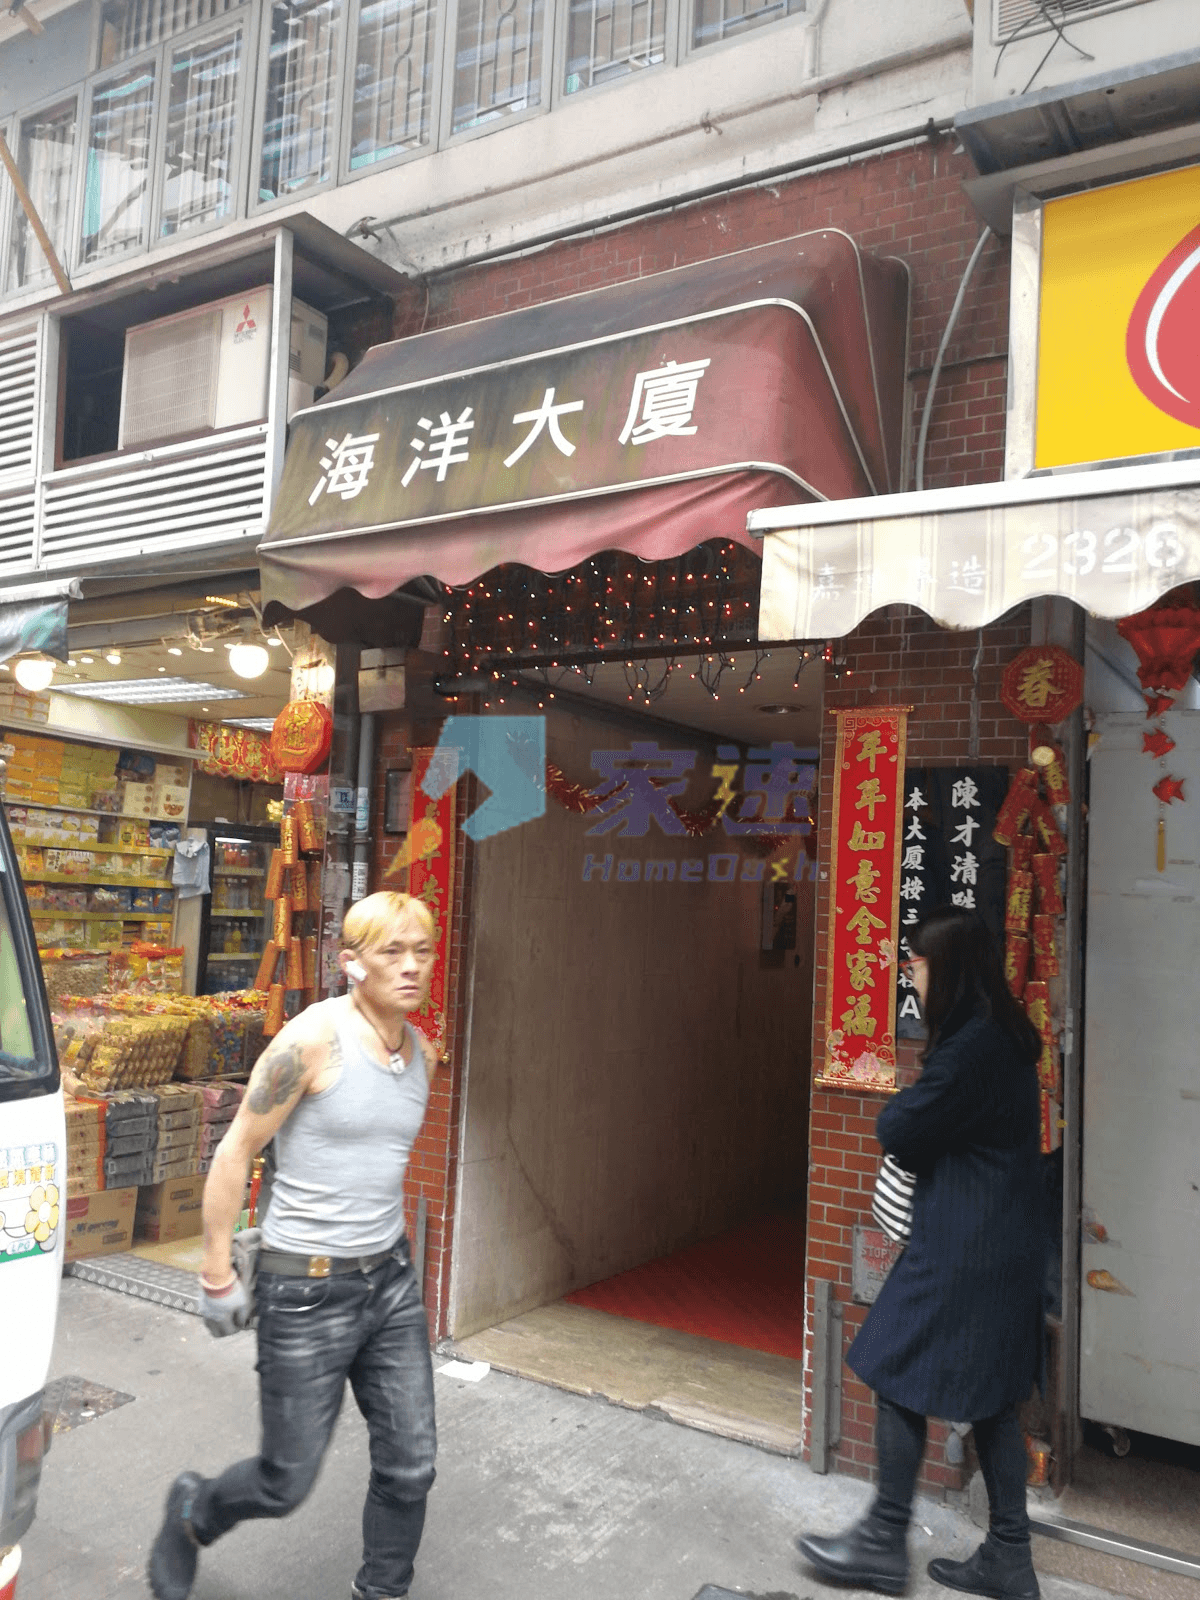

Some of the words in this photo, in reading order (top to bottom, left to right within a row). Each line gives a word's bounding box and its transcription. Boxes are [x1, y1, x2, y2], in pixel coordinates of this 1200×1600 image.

[308, 358, 711, 507] 海洋大廈
[1021, 523, 1186, 579] 2326
[1017, 659, 1065, 707] 春
[840, 729, 888, 1038] 年年如意全家福
[11, 1241, 31, 1253] LPG
